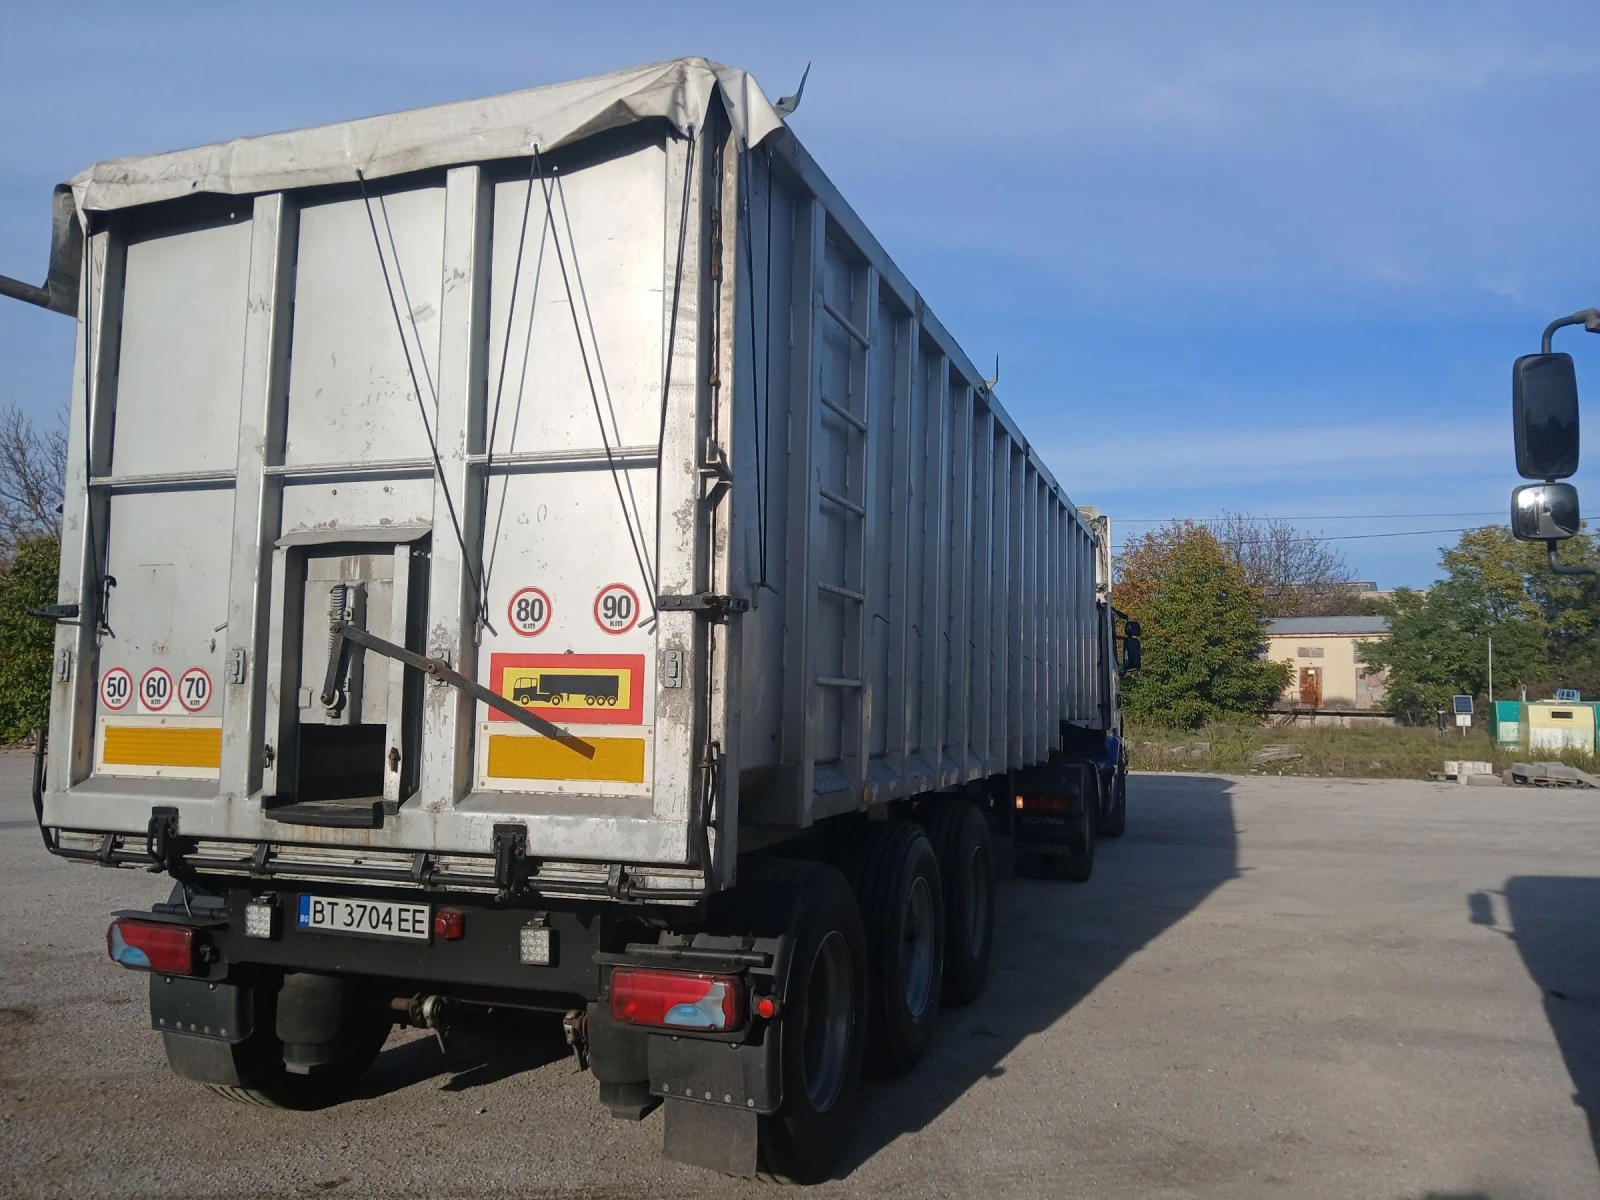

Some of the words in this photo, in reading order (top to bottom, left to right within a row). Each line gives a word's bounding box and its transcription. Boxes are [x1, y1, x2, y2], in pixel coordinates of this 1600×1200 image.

[516, 598, 544, 622] 80
[602, 595, 631, 620] 90
[107, 677, 127, 697] 50
[146, 677, 167, 698] 60
[185, 677, 206, 699] 70
[300, 915, 309, 923] BG
[313, 900, 339, 926] BT
[343, 903, 393, 931] 3704
[398, 908, 425, 934] EE
